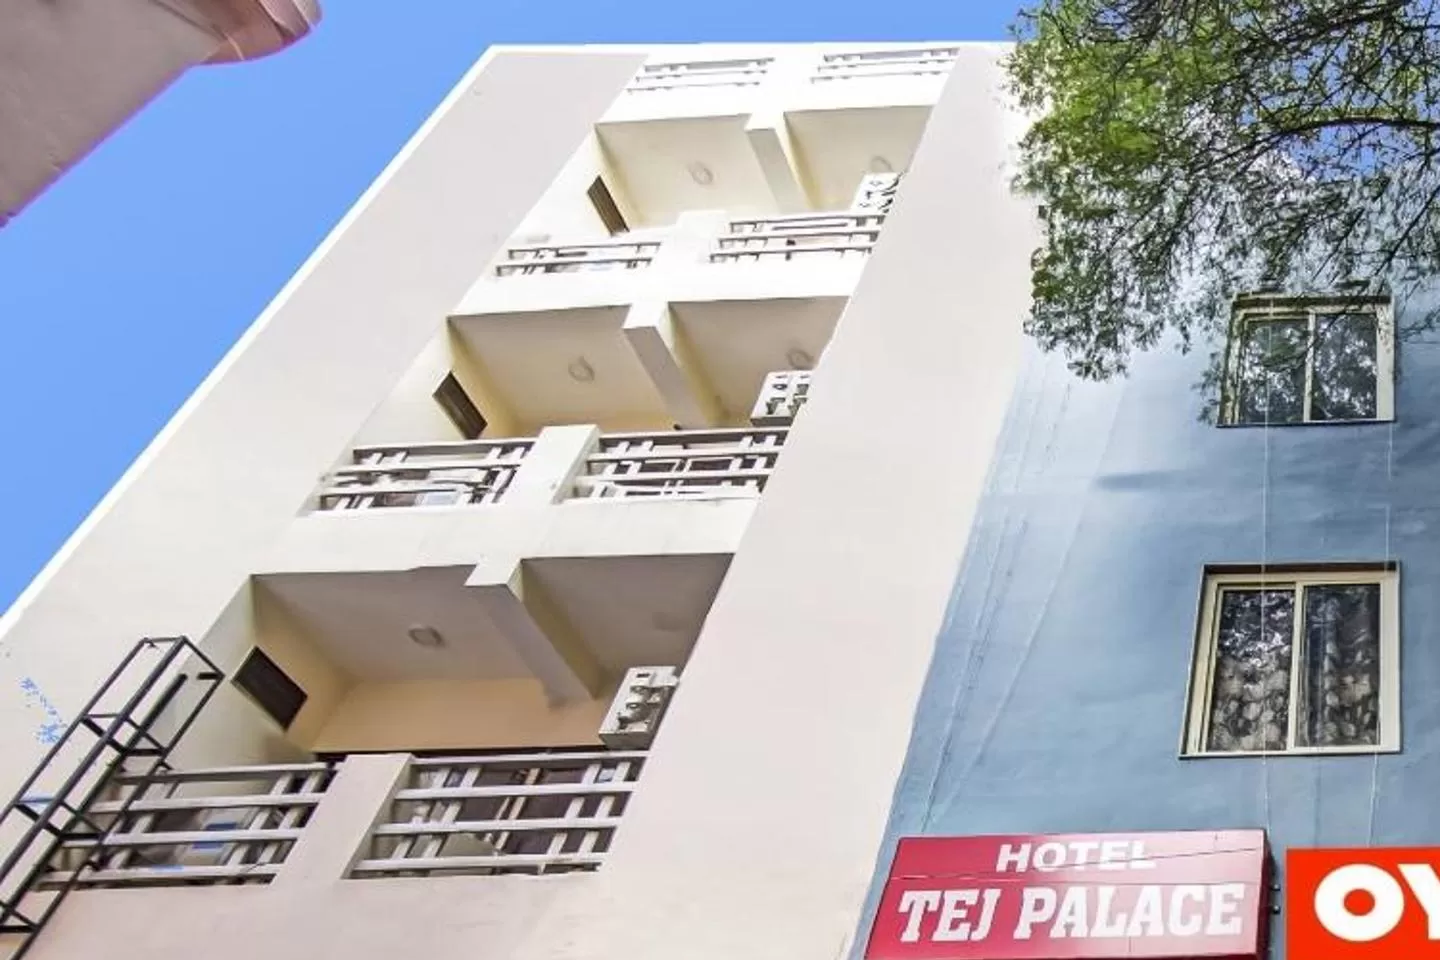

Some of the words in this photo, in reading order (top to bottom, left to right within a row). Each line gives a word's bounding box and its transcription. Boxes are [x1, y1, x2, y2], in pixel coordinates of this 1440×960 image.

[996, 840, 1157, 873] HOTEL
[898, 887, 1002, 942] TEJ
[1013, 883, 1245, 940] PALACE
